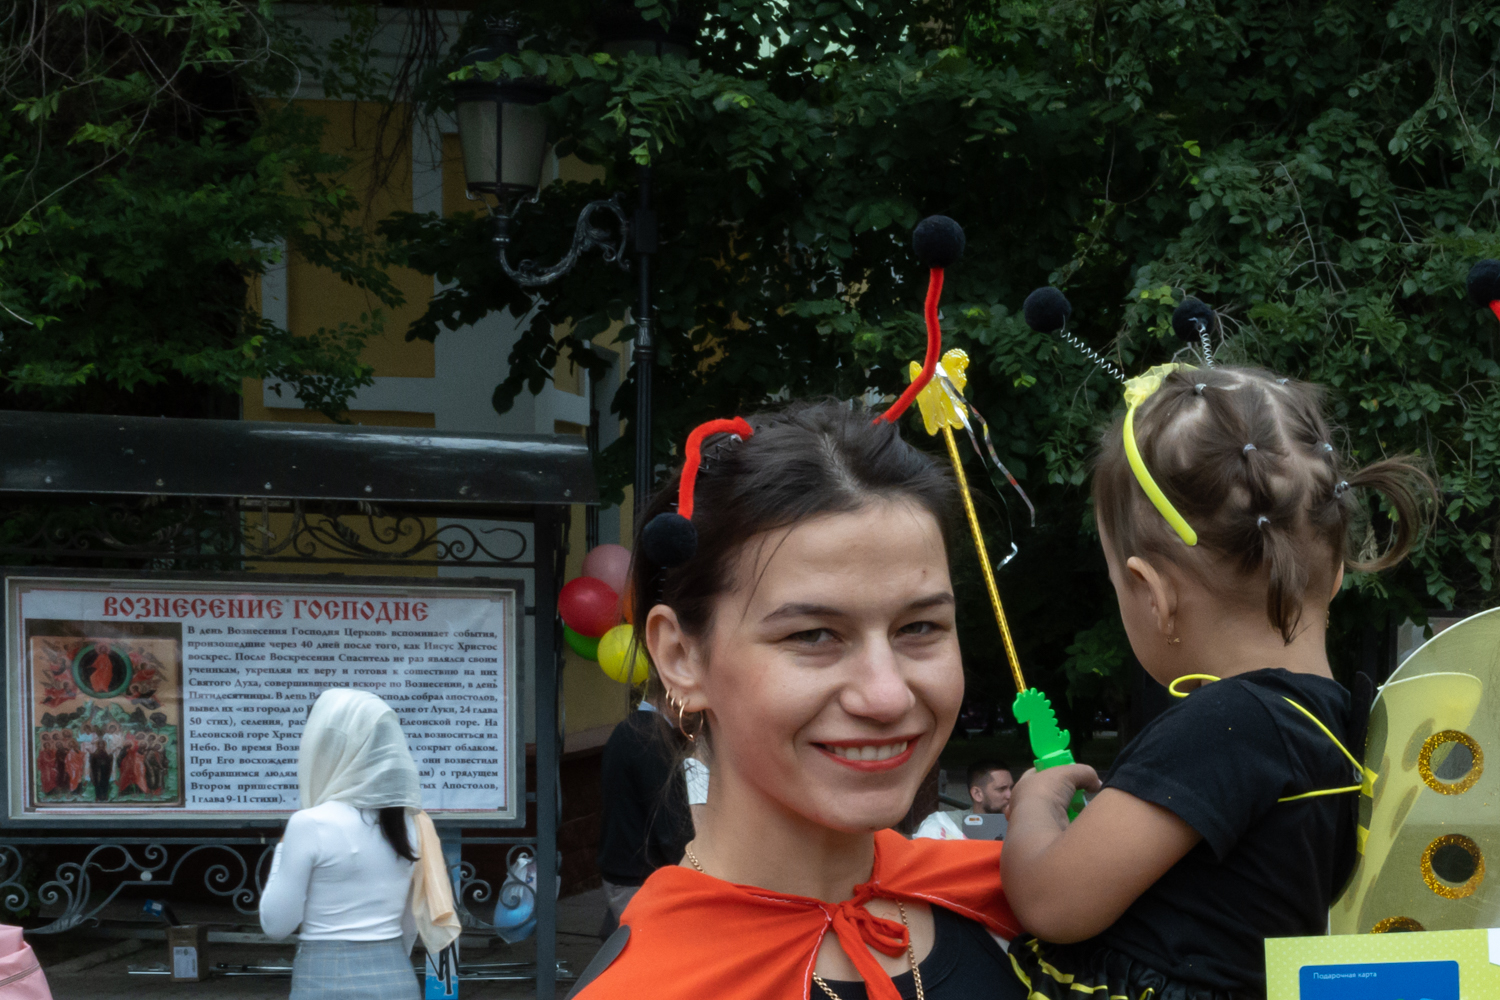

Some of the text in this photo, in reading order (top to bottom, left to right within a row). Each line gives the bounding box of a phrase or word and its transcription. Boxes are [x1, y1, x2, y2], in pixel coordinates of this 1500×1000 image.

[103, 597, 429, 624] ВОЗНЕСЕНИЕ ГОСПОДНЕ
[188, 625, 196, 634] В
[200, 627, 224, 636] день
[269, 641, 298, 651] через
[301, 640, 314, 648] 40
[316, 639, 341, 650] дней
[375, 643, 401, 651] того,
[424, 641, 455, 652] Иисус
[235, 652, 266, 661] После
[408, 656, 425, 665] раз
[314, 668, 338, 677] веру
[235, 678, 262, 689] Духа,
[353, 681, 387, 690] вскоре
[476, 682, 499, 690] день
[276, 691, 284, 700] В
[285, 693, 308, 701] день
[411, 692, 445, 703] собрал
[256, 706, 291, 715] города
[292, 706, 305, 714] до
[430, 705, 458, 716] Луки,
[460, 705, 472, 714] 24
[189, 717, 203, 725] 50
[206, 716, 237, 728] стих),
[455, 720, 481, 728] горе.
[485, 718, 499, 726] На
[247, 732, 270, 741] горе
[272, 730, 303, 741] Христ
[190, 742, 221, 751] Небо.
[224, 743, 239, 751] Во
[241, 745, 273, 754] время
[416, 745, 452, 754] сокрыт
[190, 756, 213, 767] При
[217, 756, 236, 764] Его
[264, 771, 298, 779] людям
[191, 782, 232, 792] Втором
[1313, 971, 1377, 980] Подарочная карта
